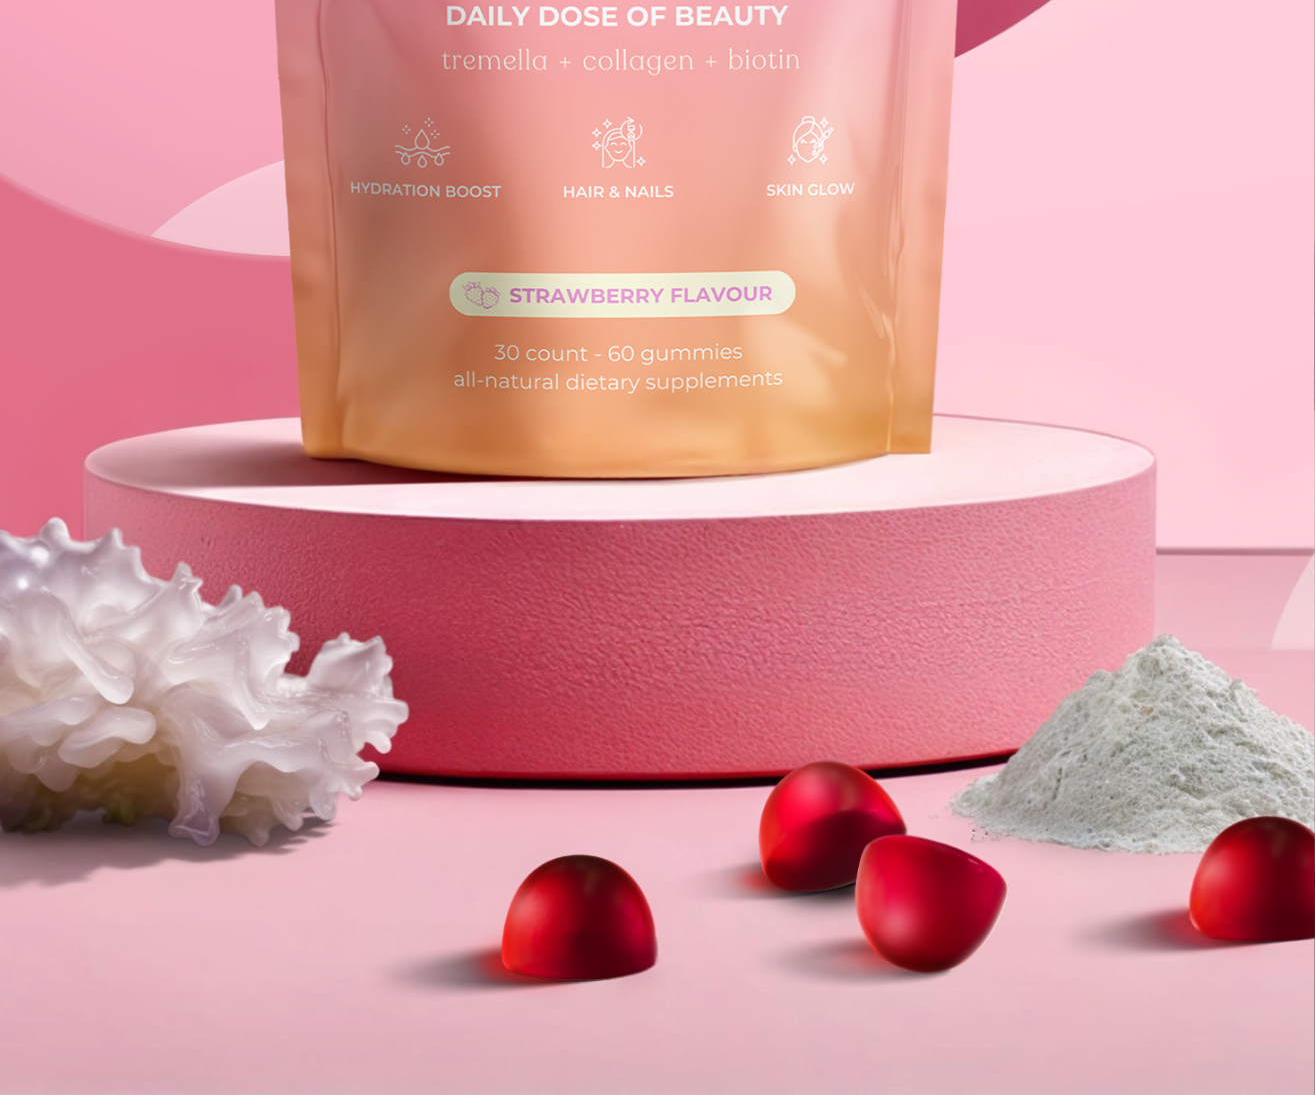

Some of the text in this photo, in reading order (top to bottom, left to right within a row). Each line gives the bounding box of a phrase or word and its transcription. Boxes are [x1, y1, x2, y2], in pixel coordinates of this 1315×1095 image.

[446, 5, 788, 26] DAILY DOSE OF BEAUTY
[441, 49, 547, 70] tremella
[582, 49, 693, 75] collagen
[728, 48, 800, 70] biotin
[350, 181, 502, 198] HYDRATION BOOST
[563, 185, 674, 198] HAIR & NAILS
[766, 182, 856, 197] SKIN GLOW
[509, 286, 773, 304] STRAWBERRY FLAVOUR
[494, 344, 520, 361] 30
[525, 346, 588, 362] count
[608, 346, 635, 362] 60
[640, 343, 743, 365] gummies
[454, 371, 783, 394] all-natural dietary supplements
